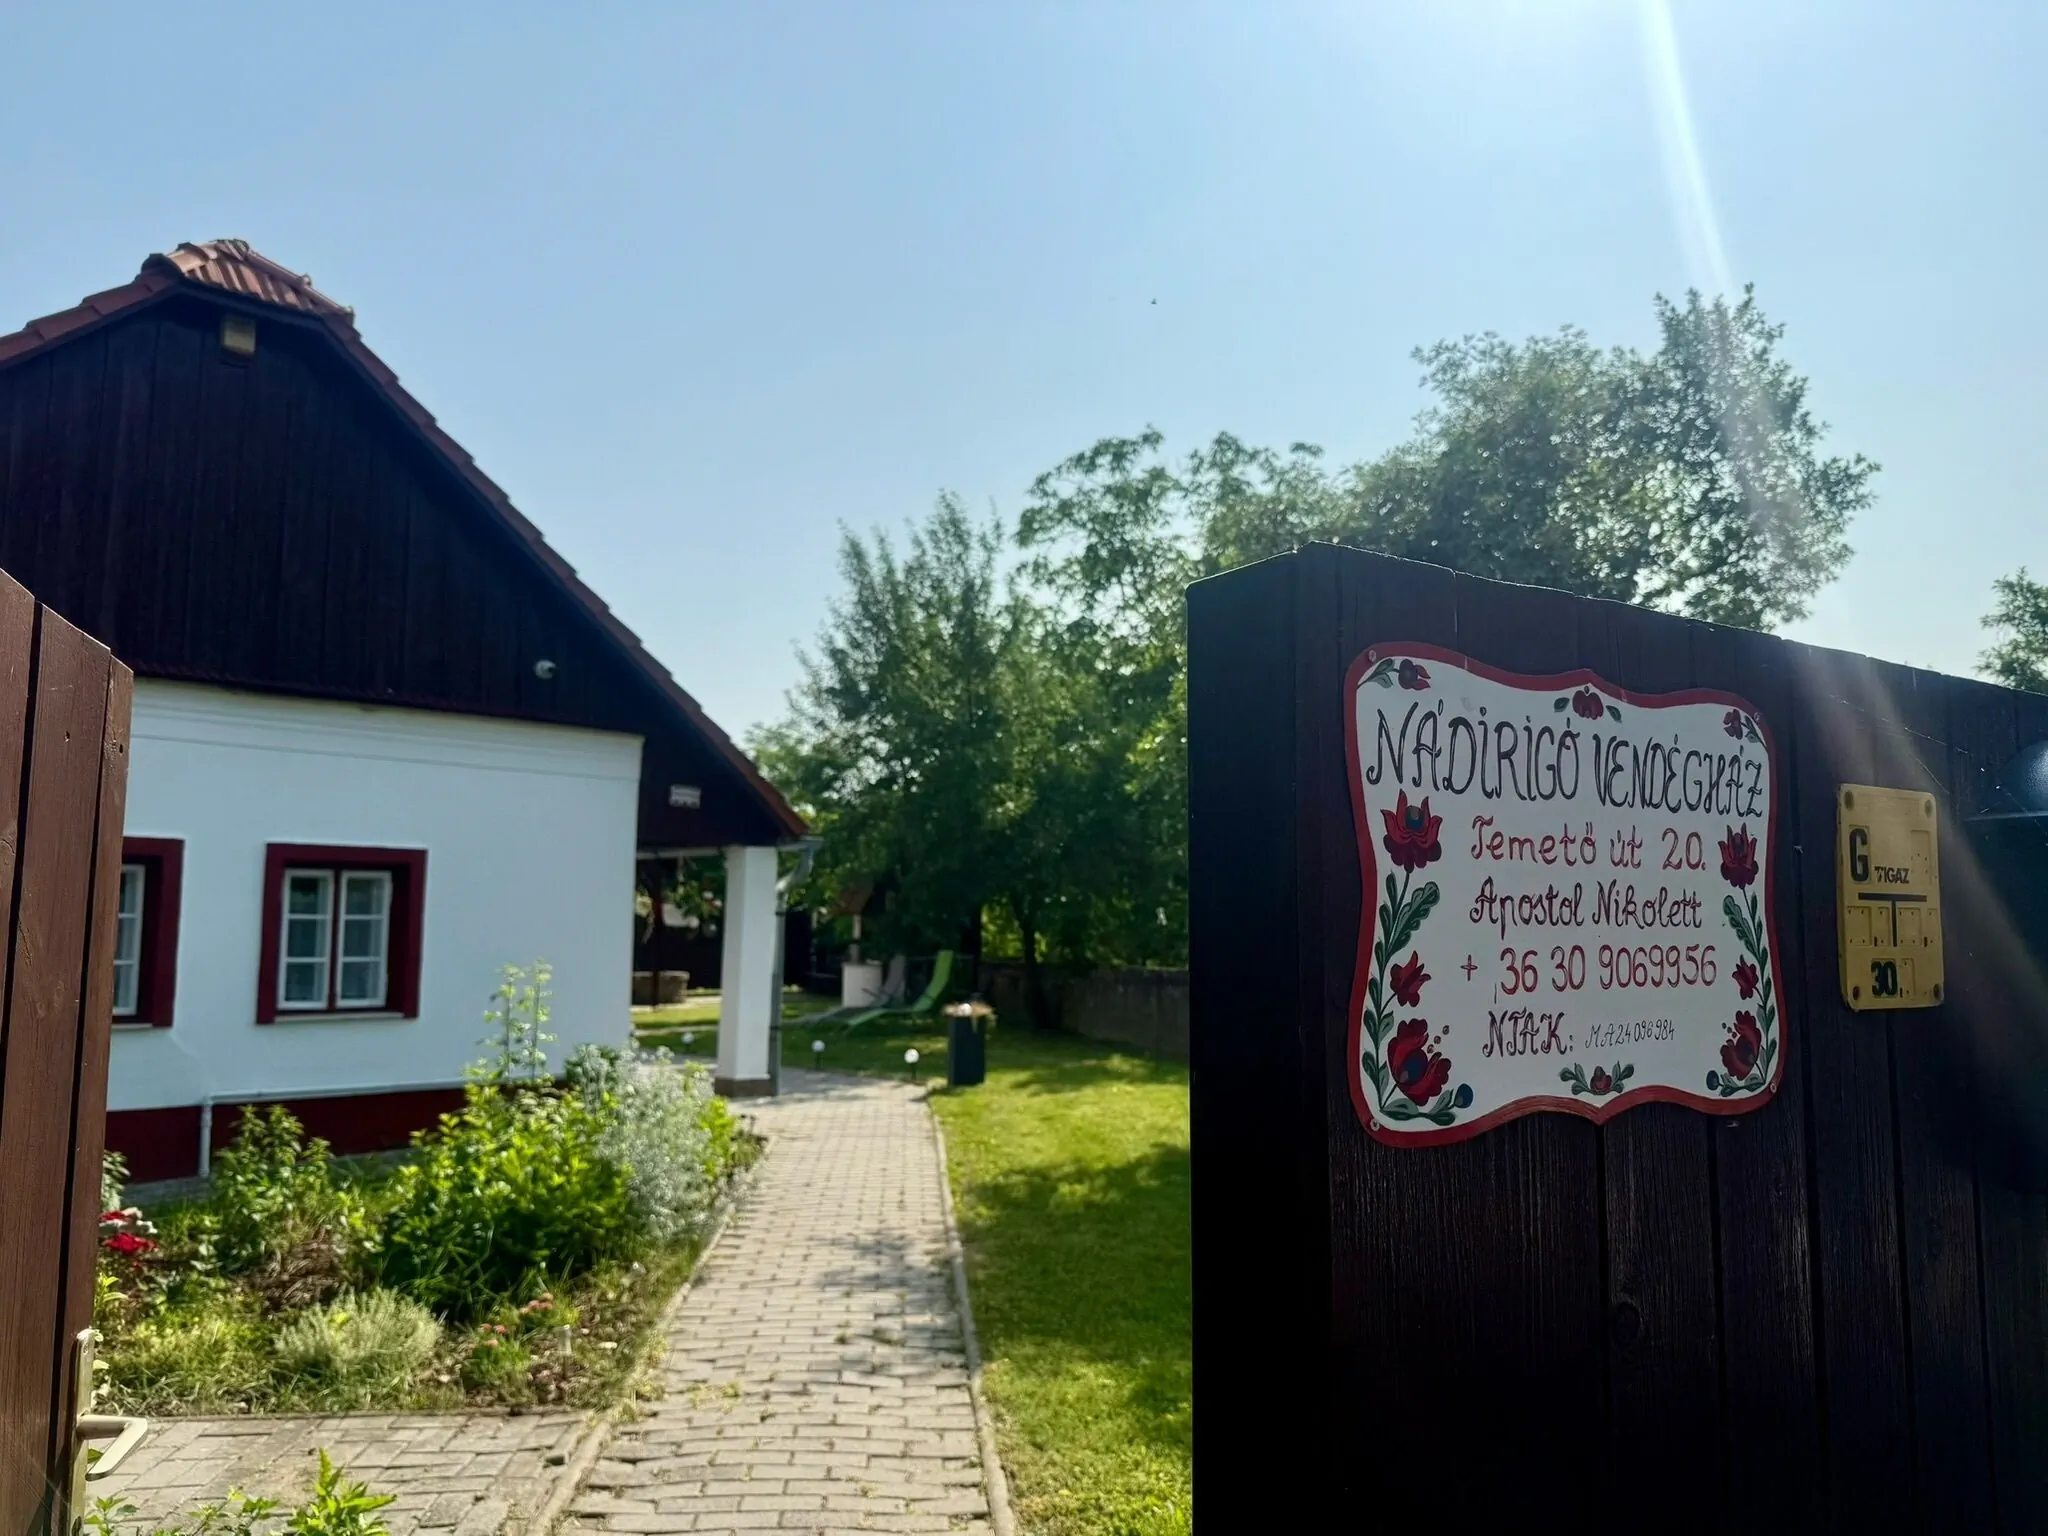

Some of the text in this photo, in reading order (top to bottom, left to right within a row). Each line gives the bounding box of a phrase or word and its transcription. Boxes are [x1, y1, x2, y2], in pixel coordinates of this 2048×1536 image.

[1592, 733, 1763, 818] VENDÉGHÁZ
[1471, 815, 1706, 871] Temető út 20.
[1850, 828, 1869, 882] G
[1469, 876, 1702, 941] Apostol Nikolett
[1500, 947, 1538, 996] 36
[1550, 944, 1586, 992] 30
[1599, 944, 1717, 990] 9069956
[1870, 961, 1898, 996] 30
[1482, 1006, 1574, 1058] NTAK:
